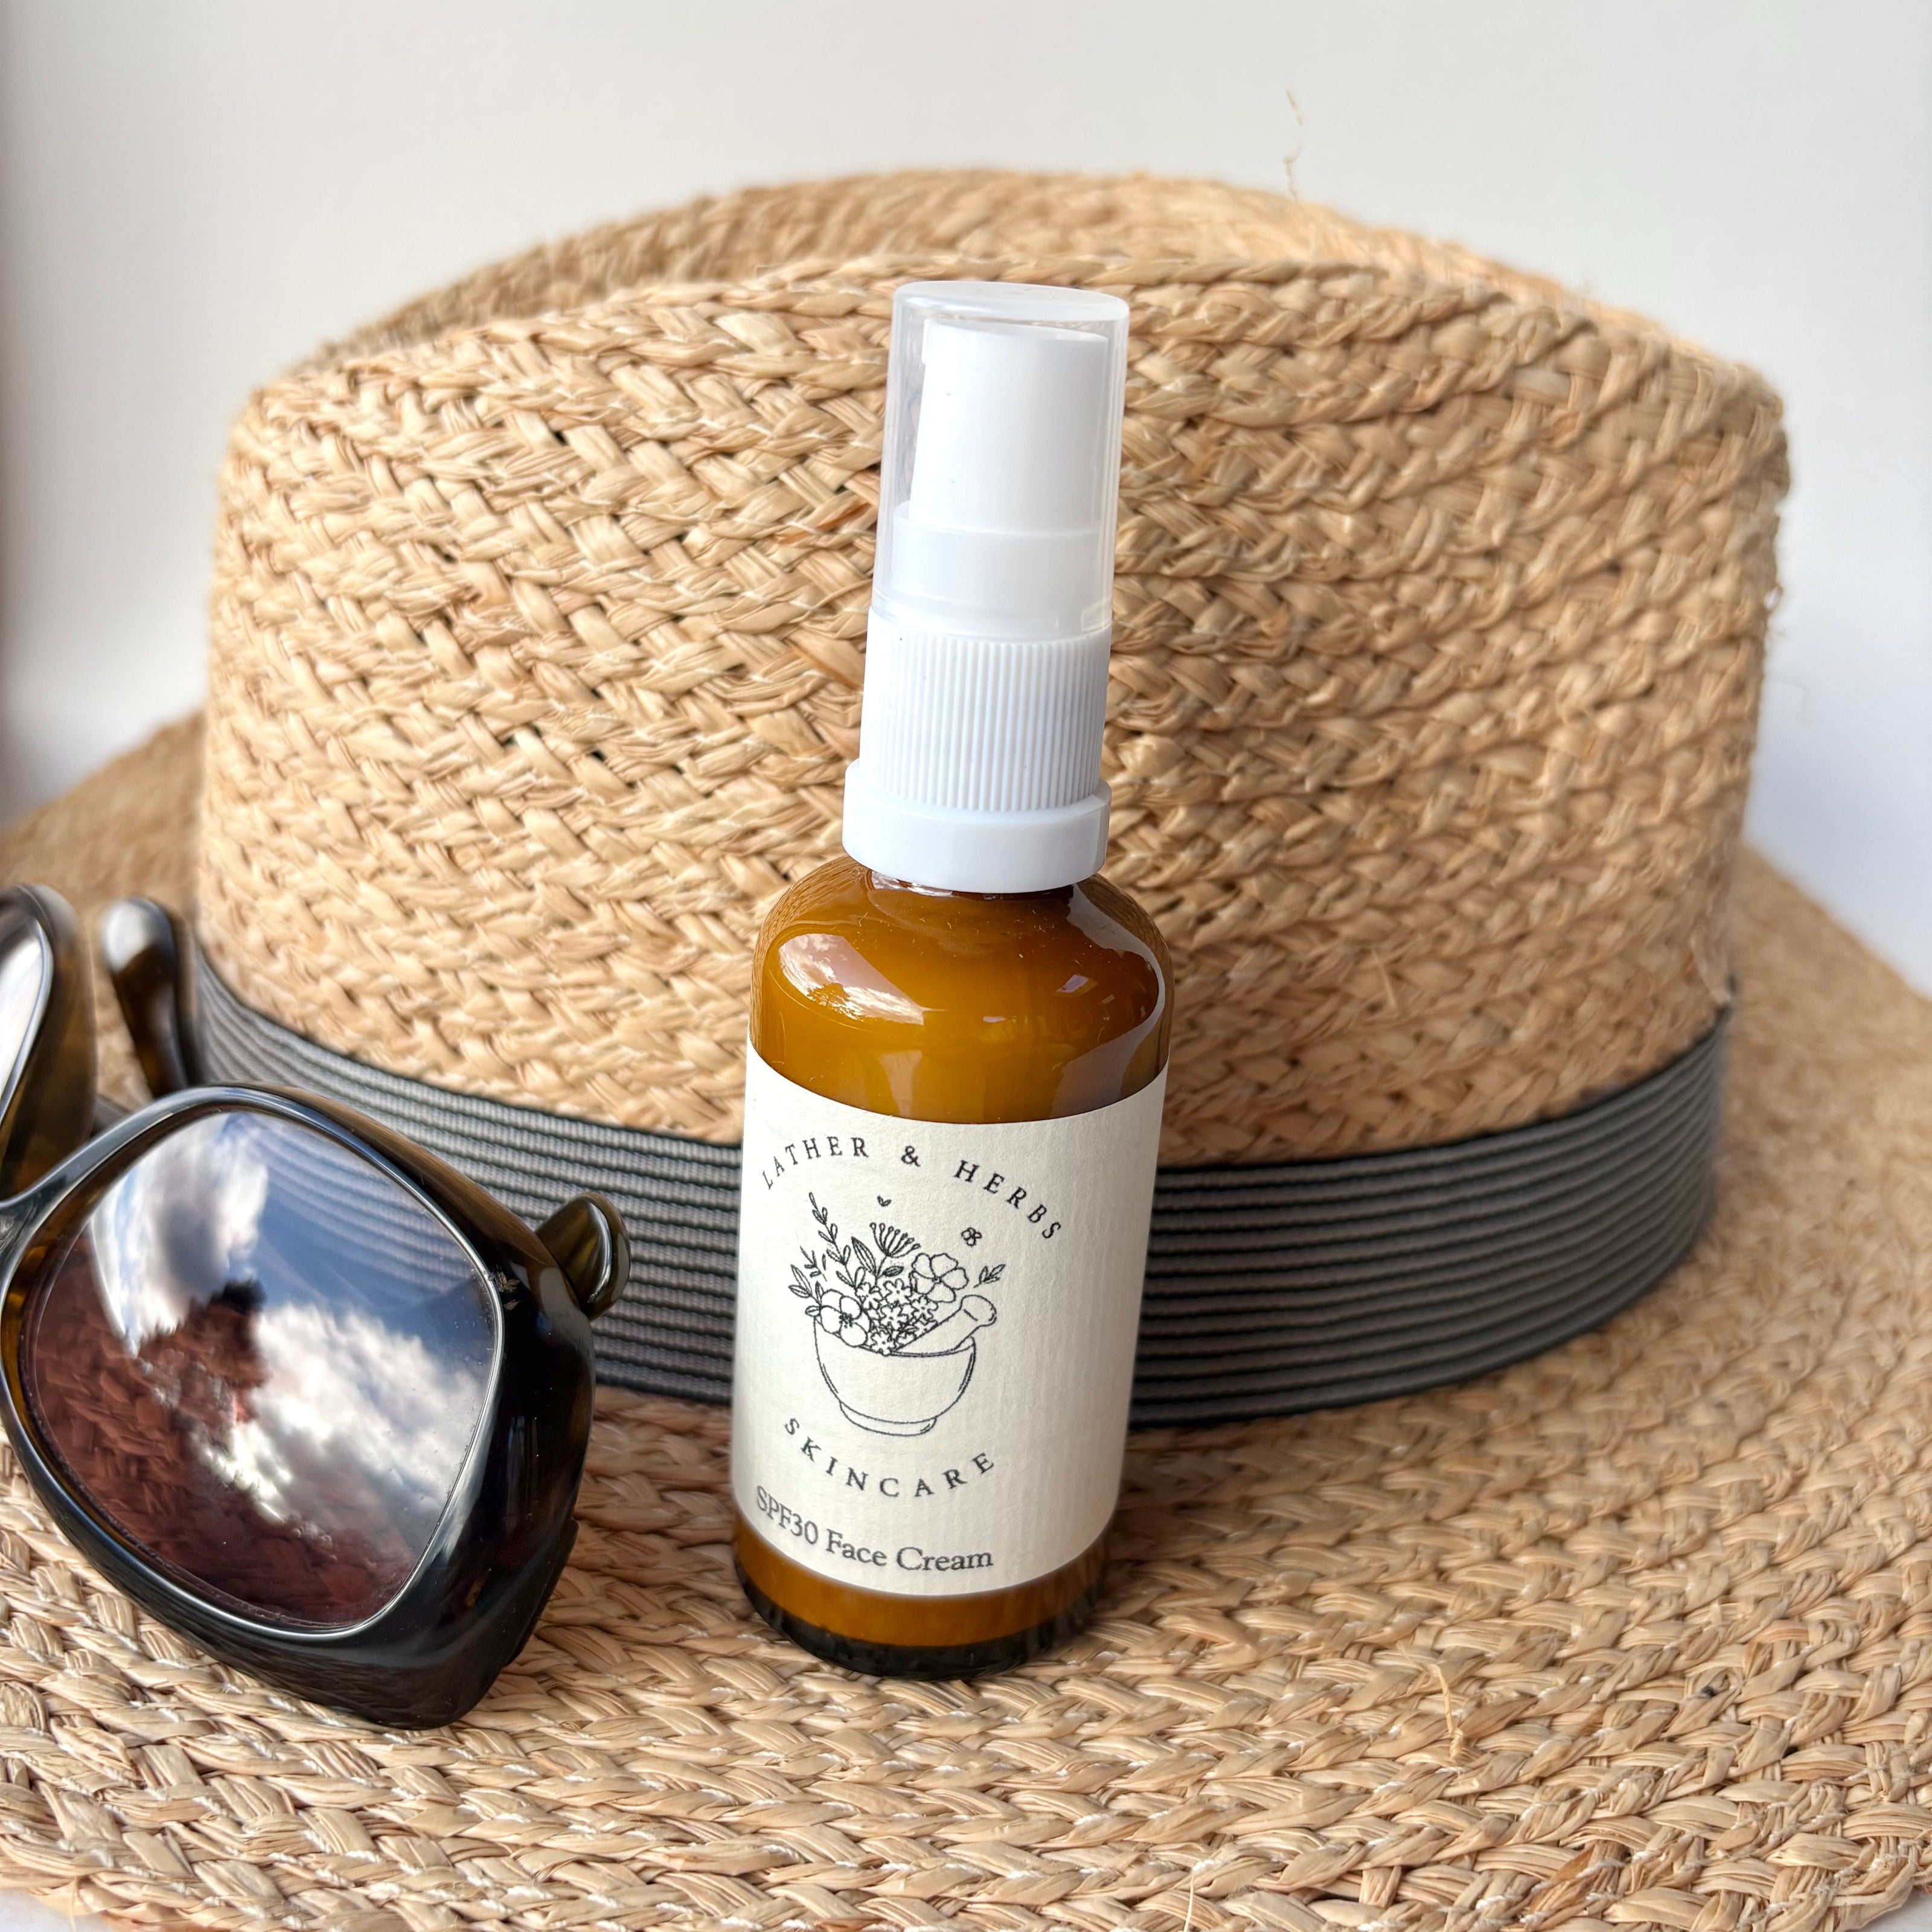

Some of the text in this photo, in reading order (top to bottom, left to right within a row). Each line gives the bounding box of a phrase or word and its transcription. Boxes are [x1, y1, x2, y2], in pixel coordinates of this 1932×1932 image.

[763, 1136, 1061, 1239] LATHER & HERBS
[784, 1418, 994, 1497] SKINCARE
[756, 1486, 994, 1571] SPF30 Face Cream
